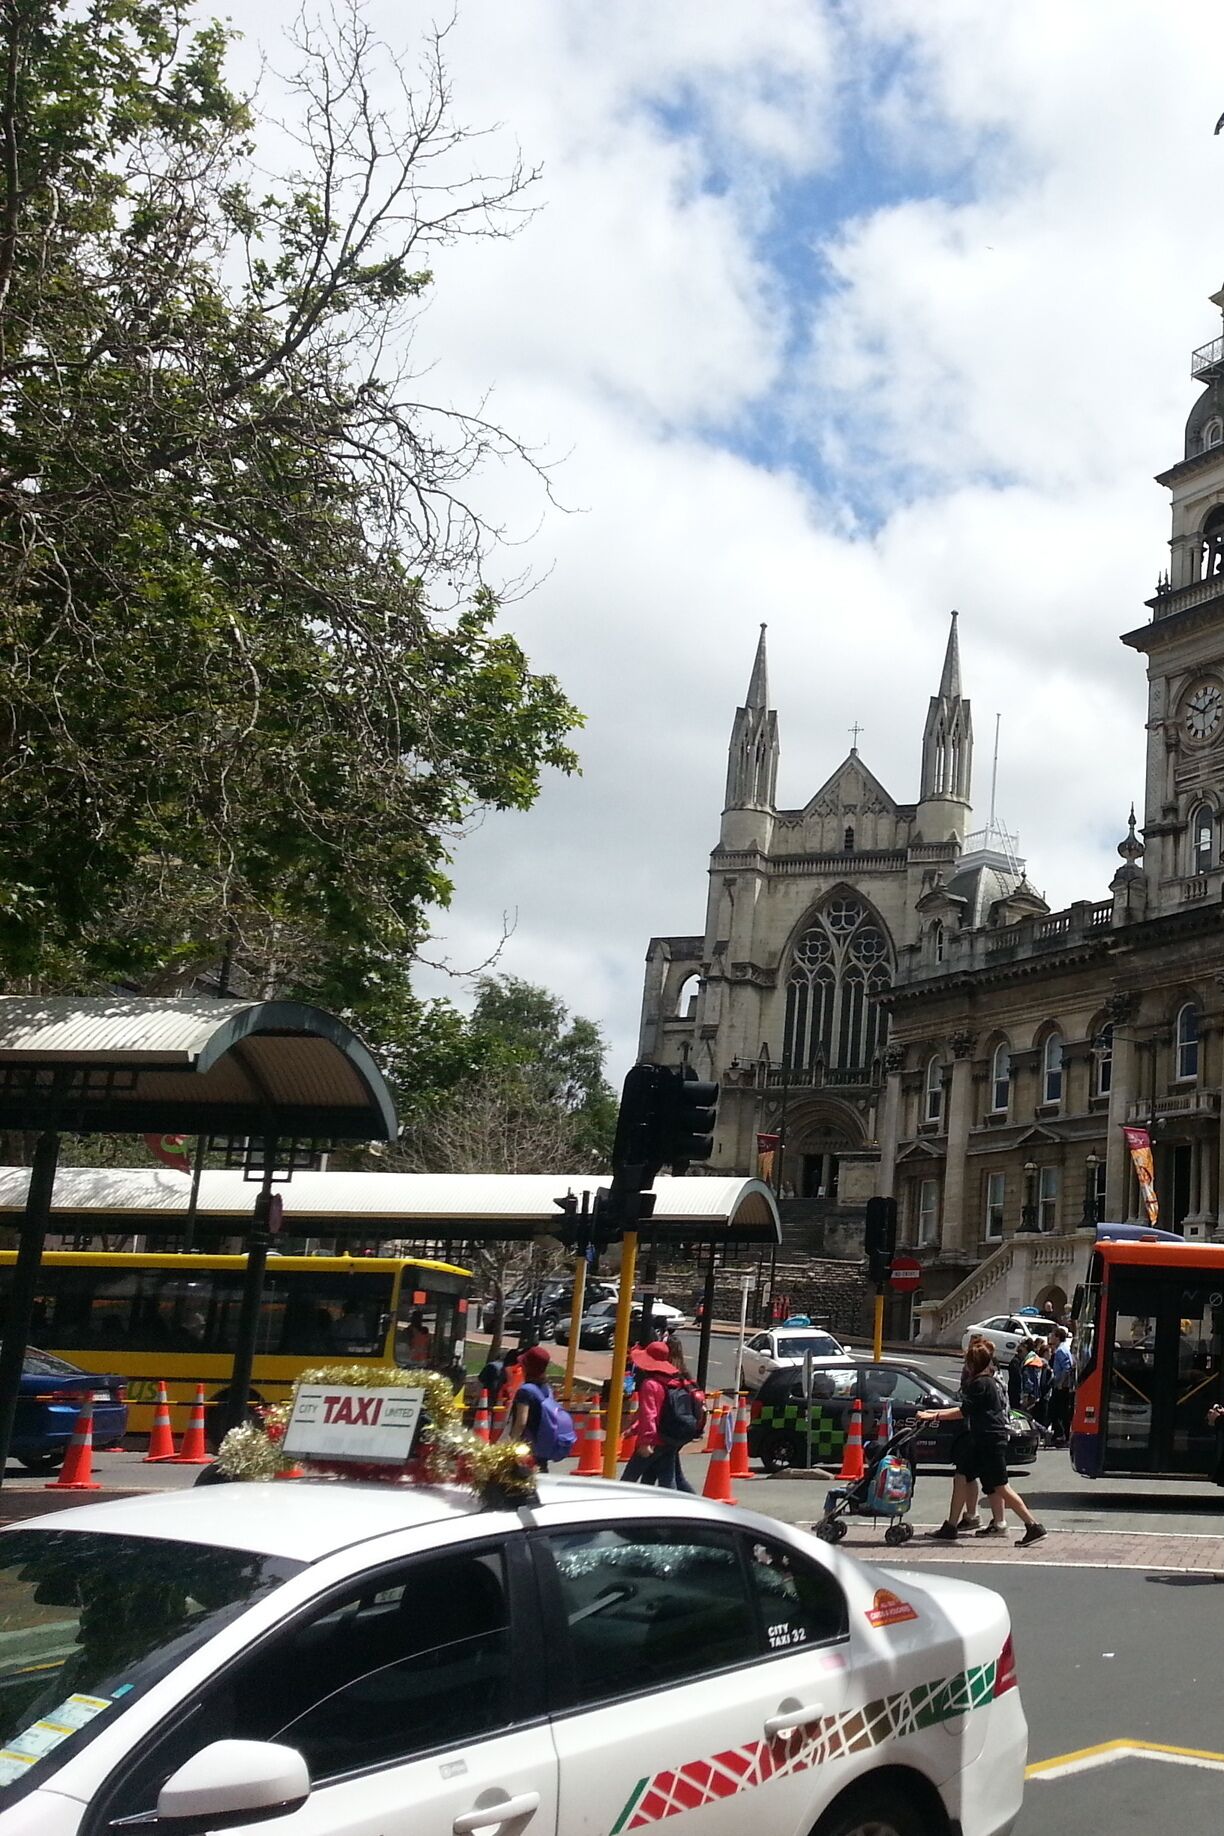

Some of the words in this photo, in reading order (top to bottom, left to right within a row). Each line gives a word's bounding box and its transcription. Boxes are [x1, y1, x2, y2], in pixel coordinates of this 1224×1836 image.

[299, 1404, 319, 1414] CITY
[323, 1396, 384, 1426] TAXI
[384, 1408, 414, 1418] UNITED
[768, 1622, 789, 1637] CITY
[769, 1634, 791, 1648] TAXI
[791, 1627, 807, 1643] 32
